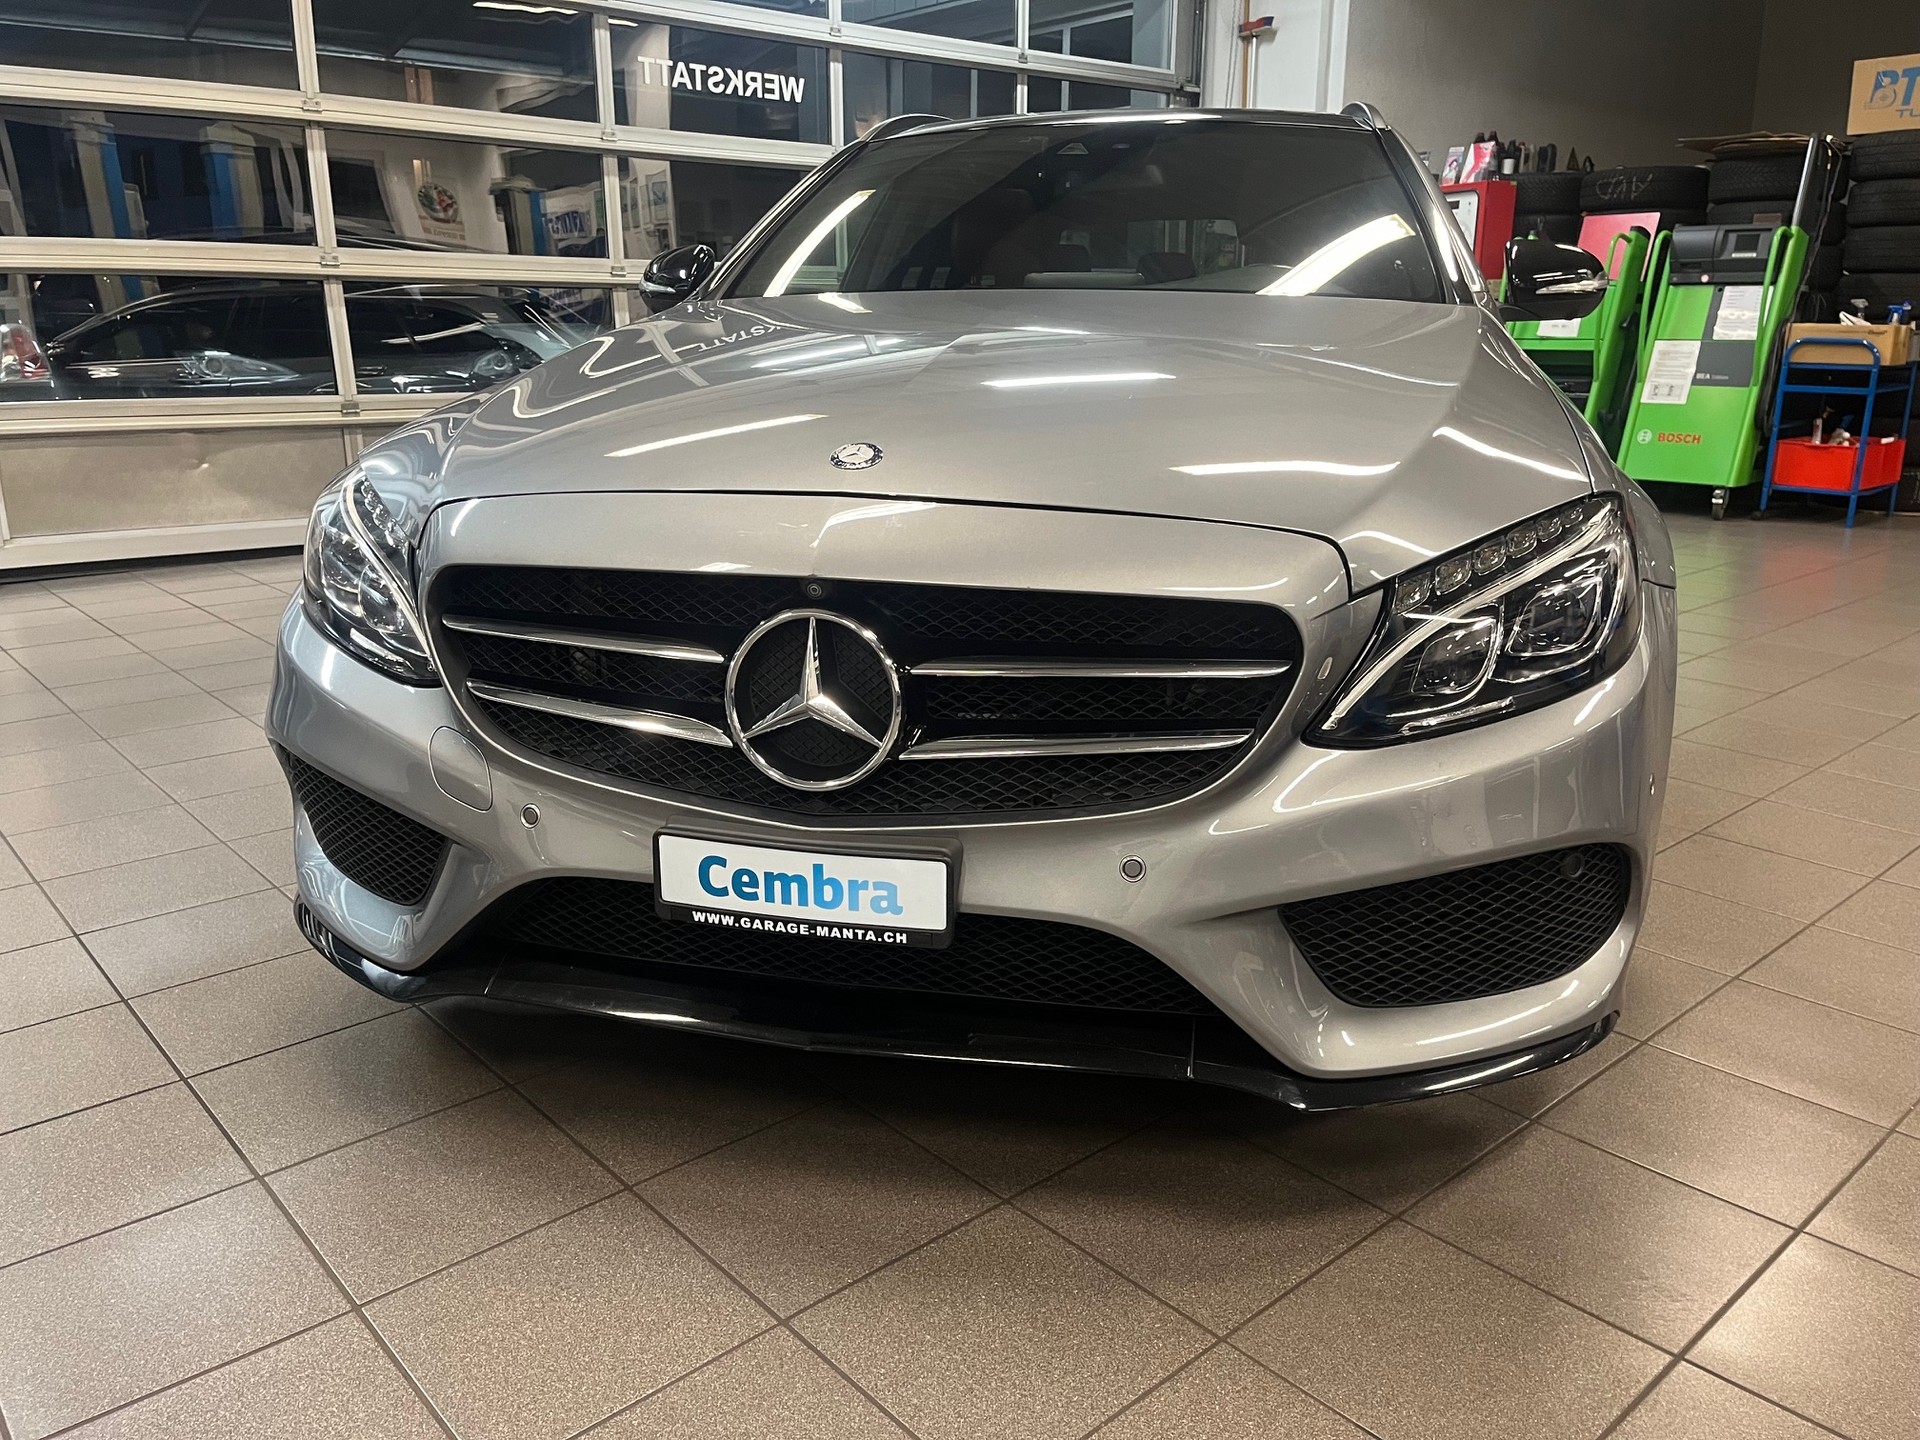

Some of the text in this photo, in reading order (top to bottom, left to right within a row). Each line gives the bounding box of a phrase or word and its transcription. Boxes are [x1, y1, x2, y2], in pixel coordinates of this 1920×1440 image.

[1657, 432, 1701, 445] BOSCH
[698, 855, 904, 916] Cembra
[692, 910, 908, 944] WWW.GARAGE-MANTA.CH
